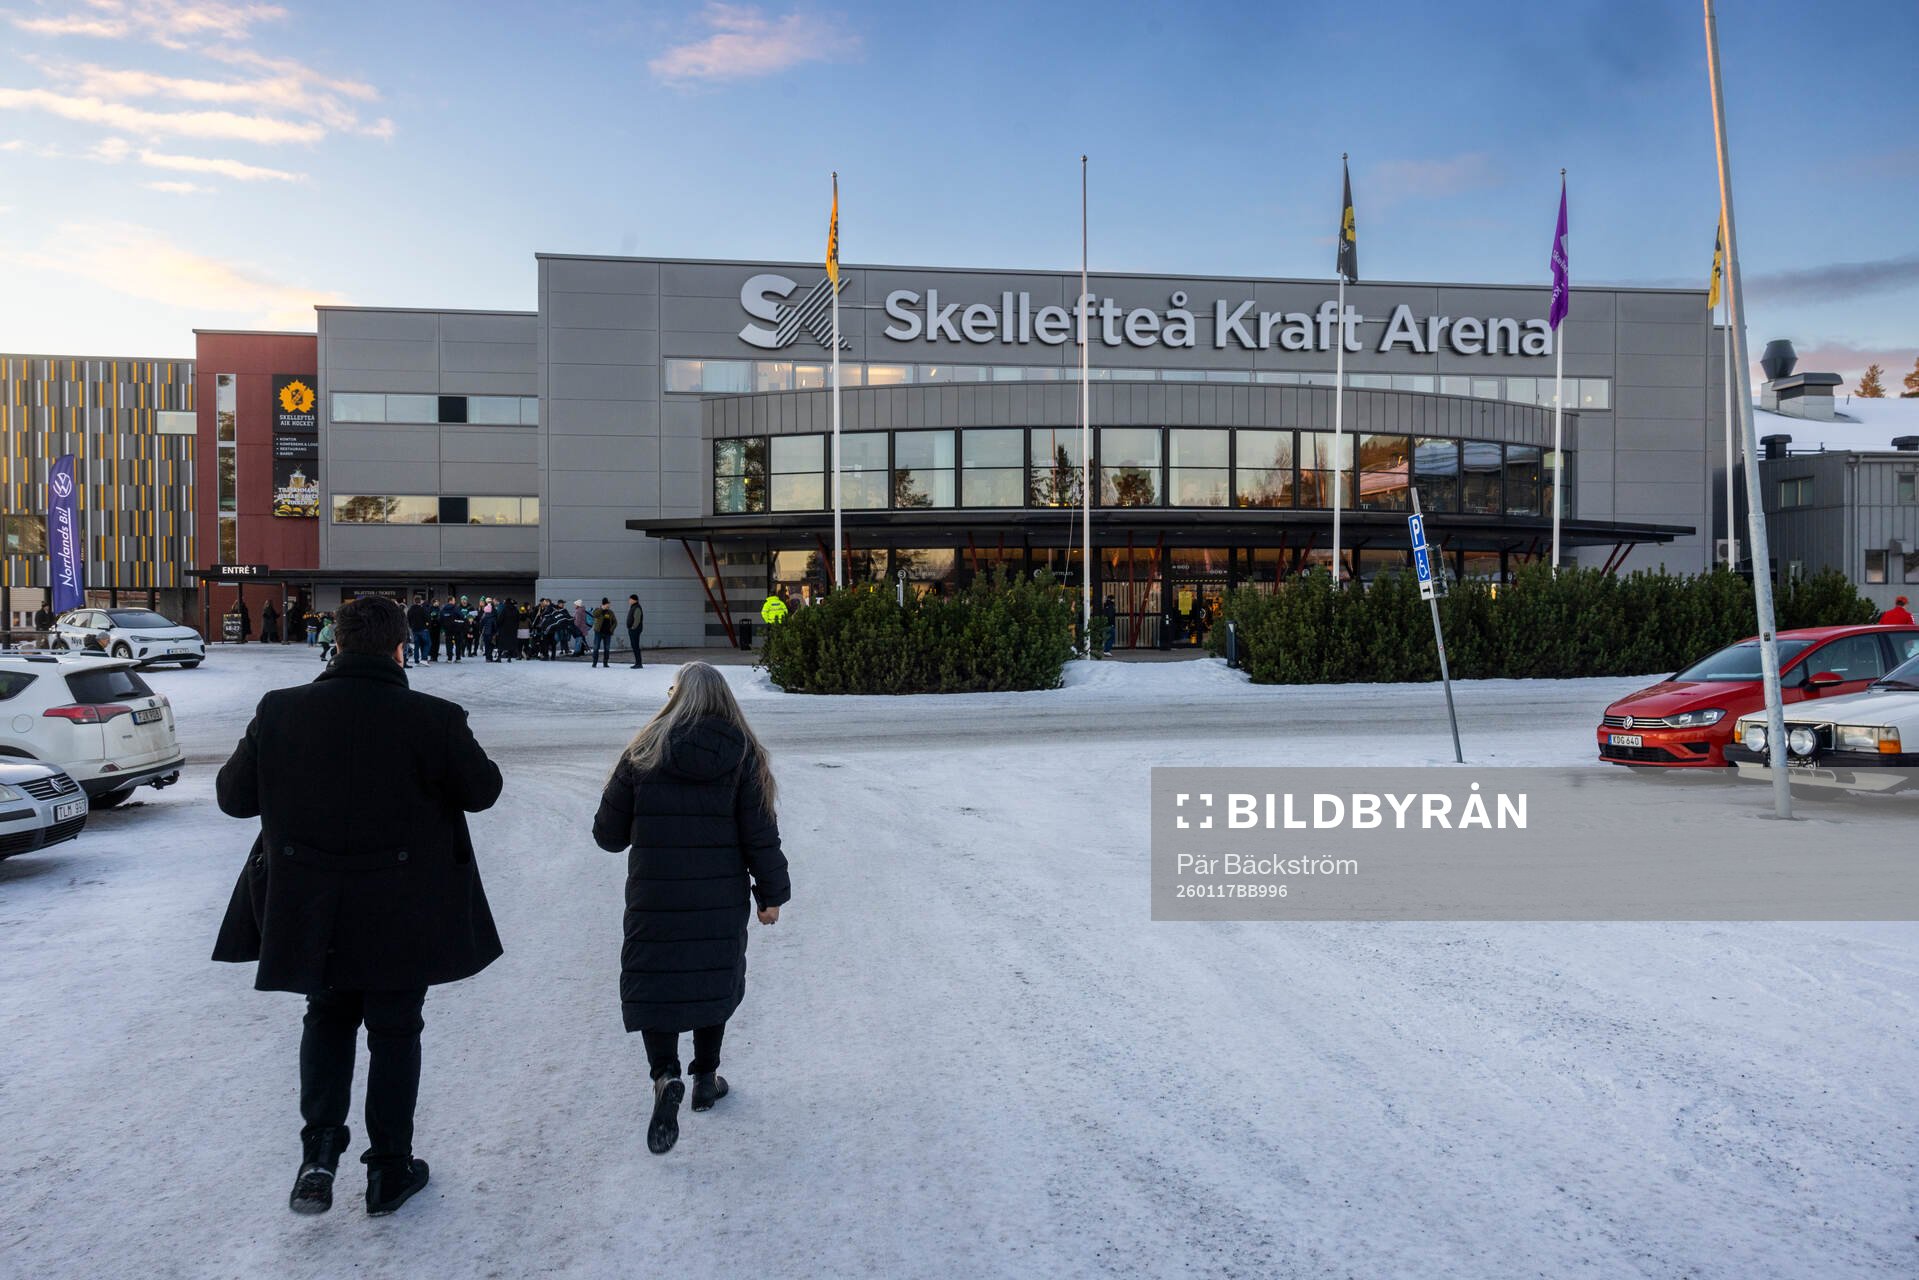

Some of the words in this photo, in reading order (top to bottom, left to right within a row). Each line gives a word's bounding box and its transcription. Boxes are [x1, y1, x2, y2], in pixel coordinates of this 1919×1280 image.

[884, 289, 1197, 347] Skellefteå
[1215, 299, 1363, 352] Kraft
[1379, 304, 1554, 356] Arena
[56, 506, 68, 525] Bil
[1411, 518, 1420, 545] P
[57, 528, 74, 587] Norrlands
[222, 565, 250, 575] ENTRÉ
[252, 566, 257, 575] 1
[71, 637, 82, 648] Nya
[1626, 736, 1640, 746] 640
